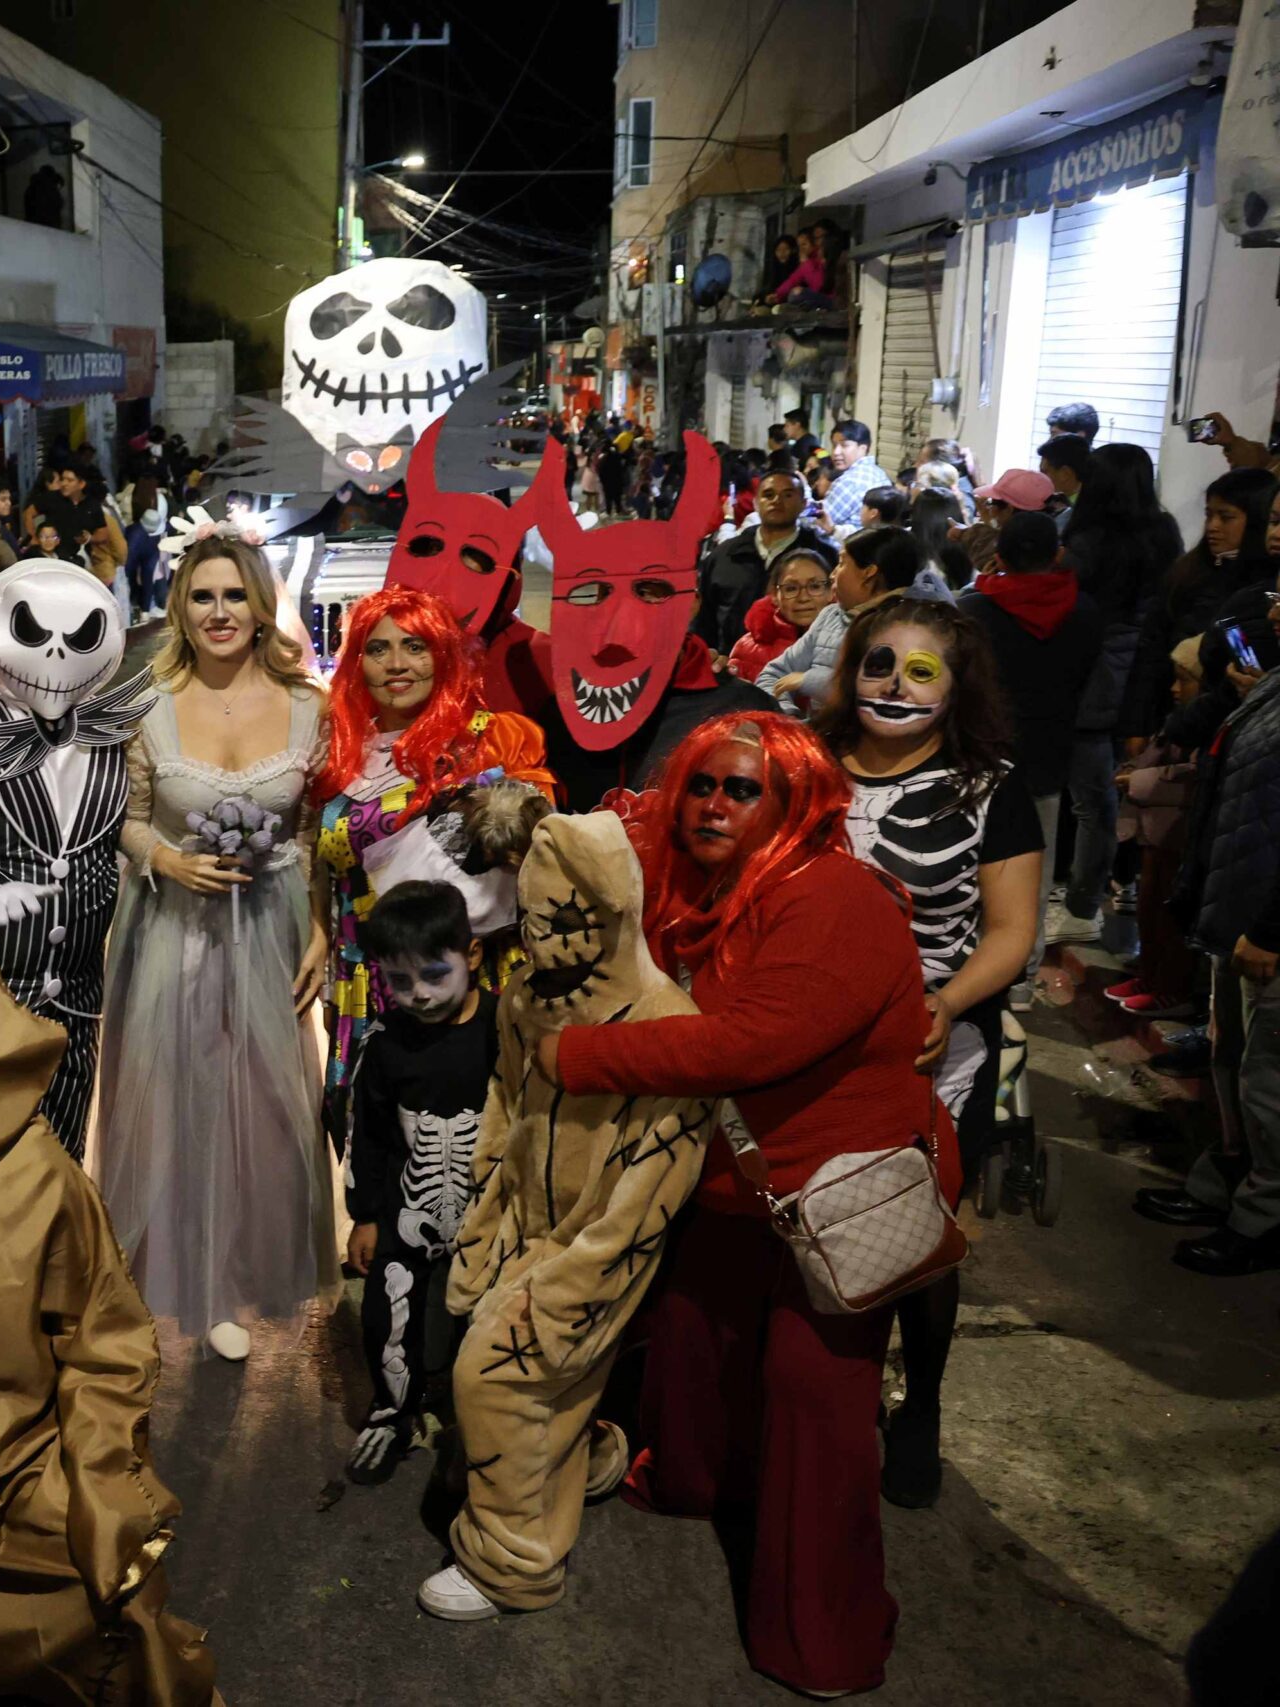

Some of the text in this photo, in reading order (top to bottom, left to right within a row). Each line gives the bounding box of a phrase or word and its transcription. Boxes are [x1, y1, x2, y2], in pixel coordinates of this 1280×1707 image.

[1047, 109, 1186, 195] ACCESORIOS
[45, 353, 81, 381] POLLO
[83, 351, 123, 378] FRESCO
